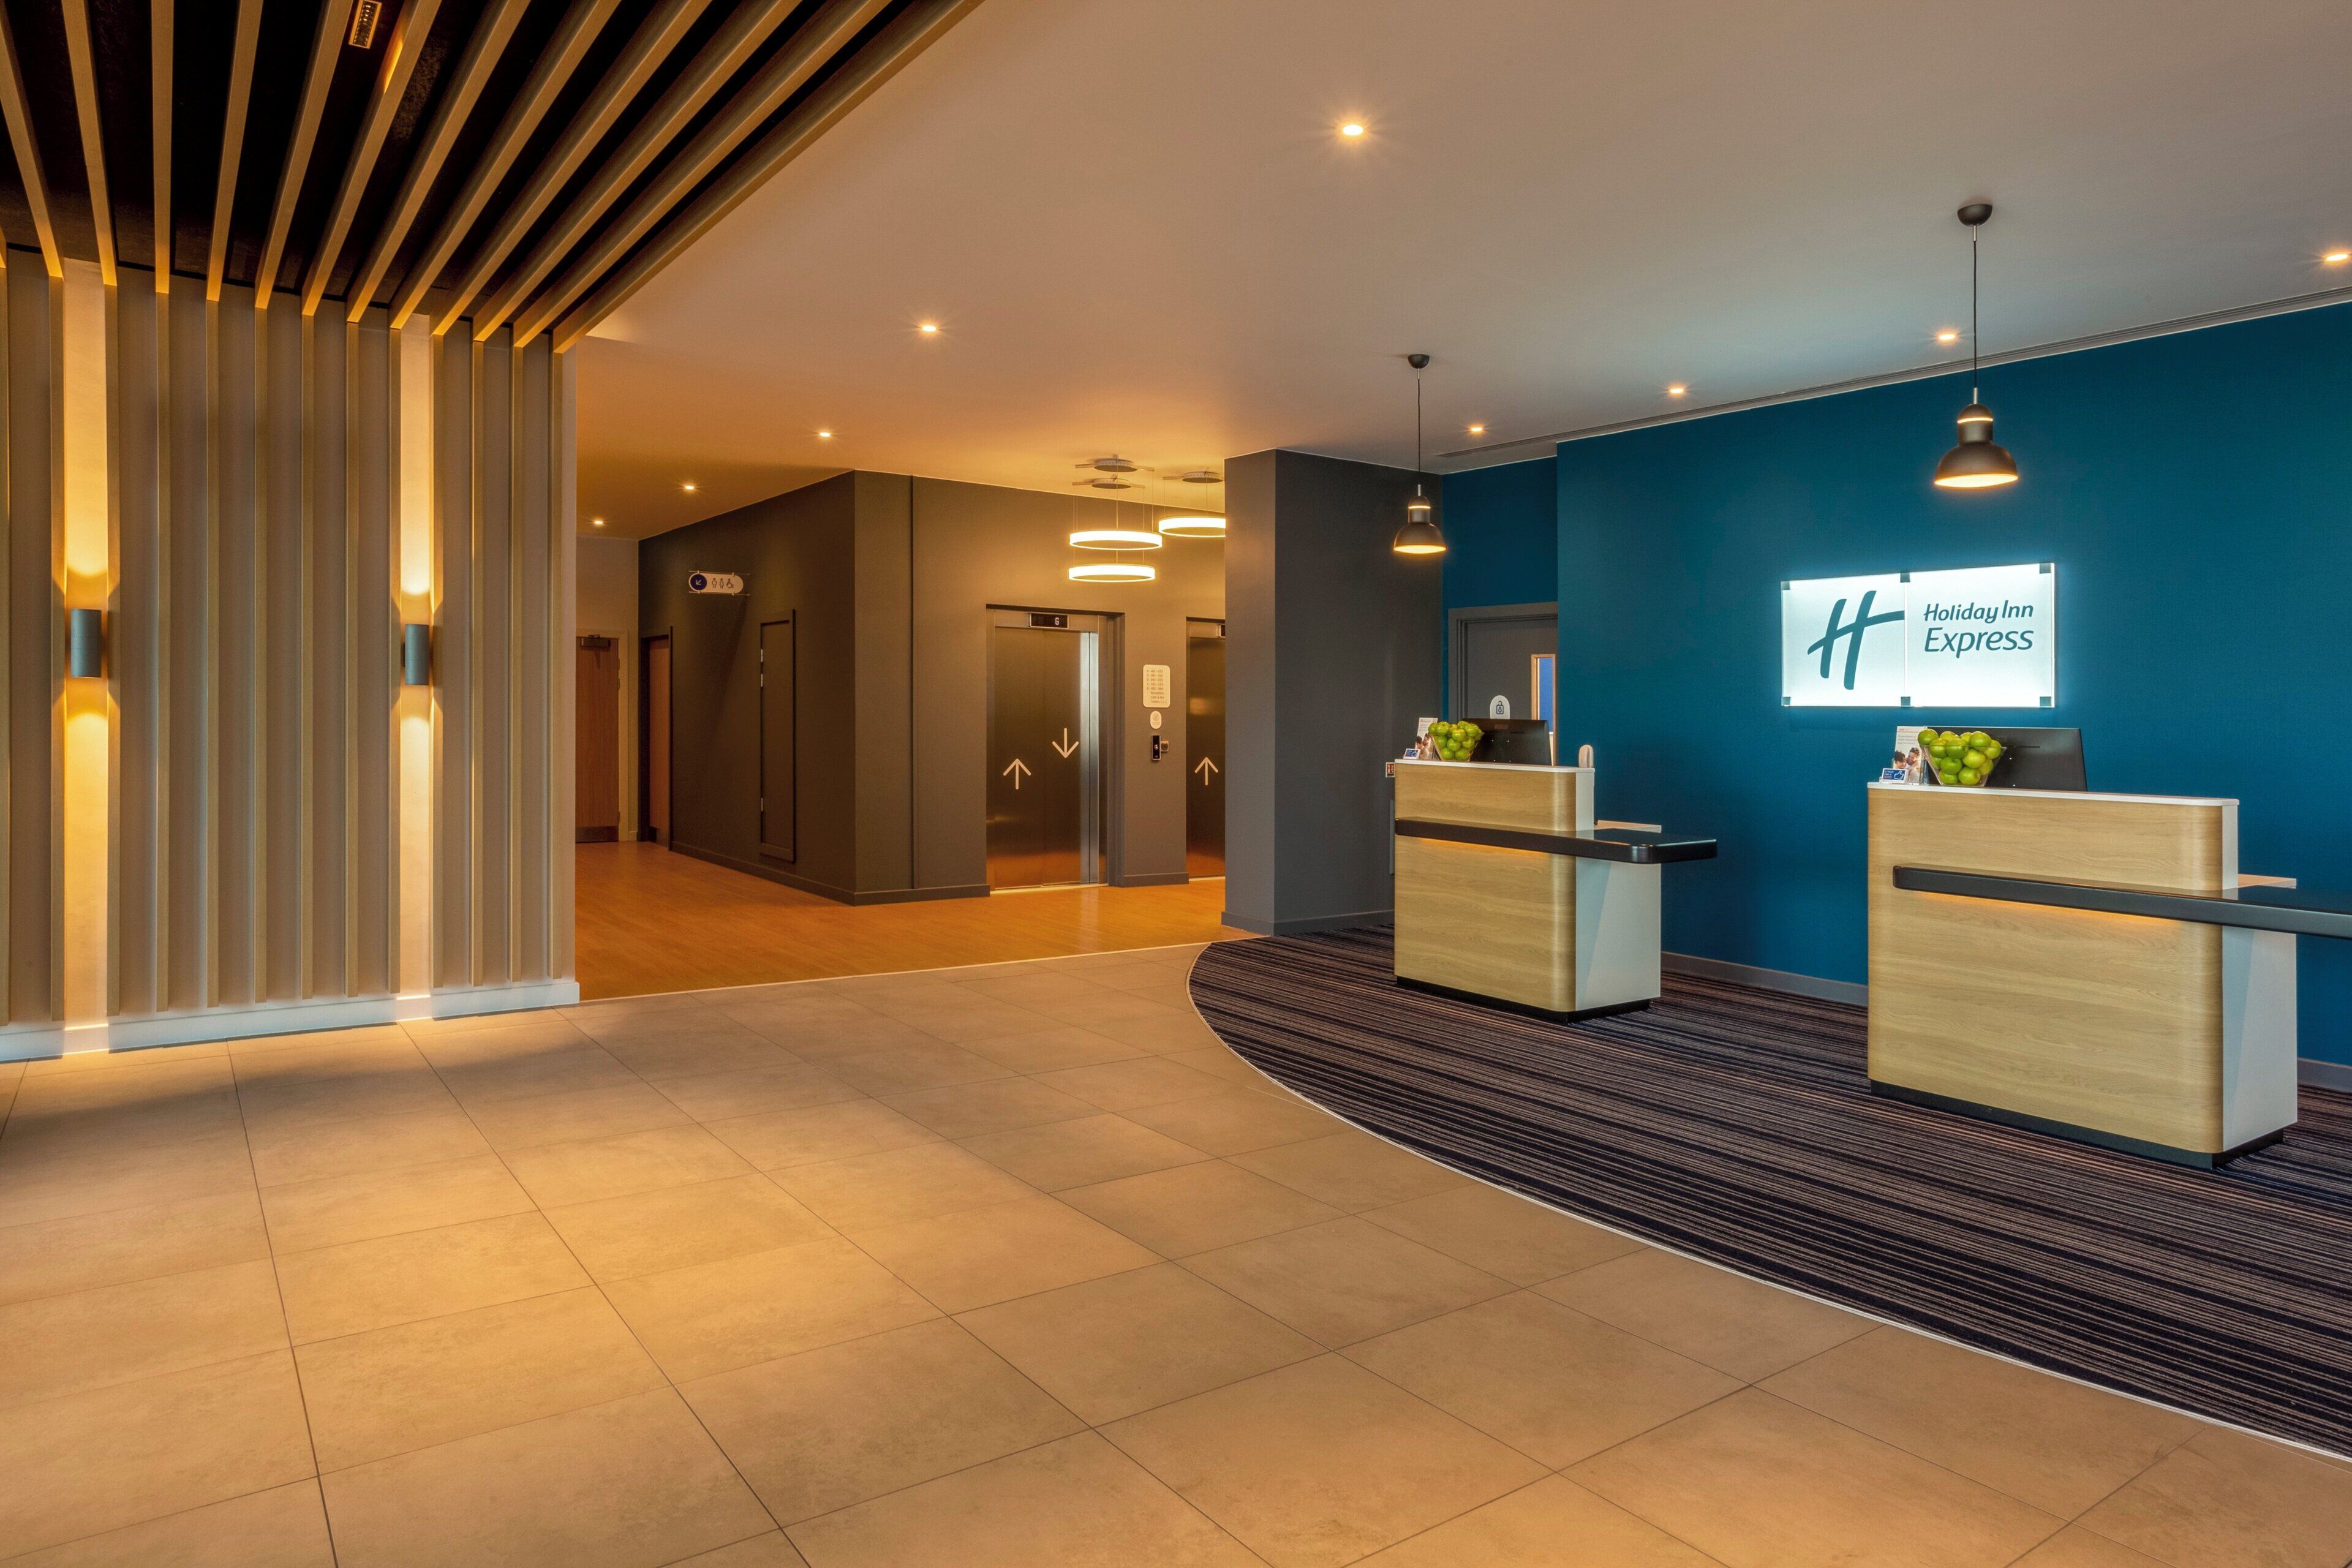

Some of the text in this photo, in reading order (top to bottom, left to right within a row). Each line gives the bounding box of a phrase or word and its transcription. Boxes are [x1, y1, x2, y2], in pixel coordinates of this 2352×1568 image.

[1923, 600, 2034, 624] Holiday Inn
[1924, 627, 2034, 658] Express
